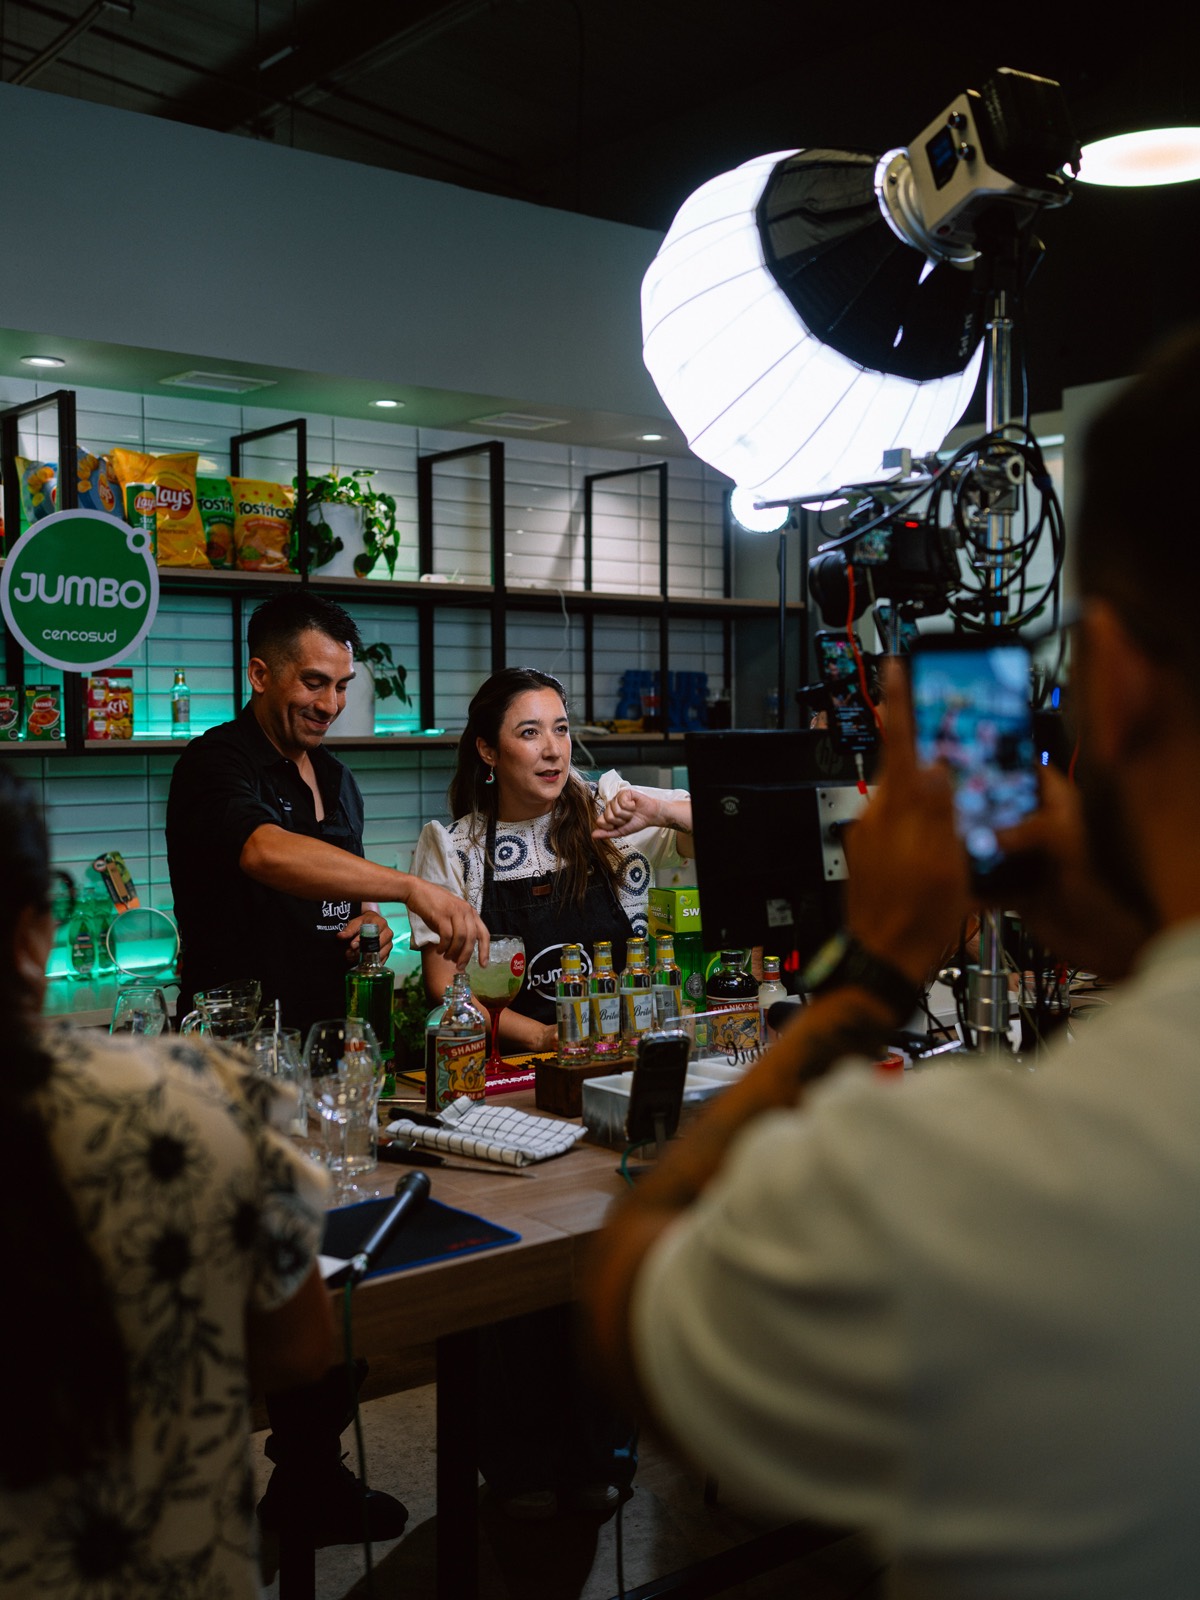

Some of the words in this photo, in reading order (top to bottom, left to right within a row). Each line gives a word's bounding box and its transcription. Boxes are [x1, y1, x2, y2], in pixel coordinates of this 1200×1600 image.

[155, 485, 191, 511] Lay's
[198, 497, 233, 512] Tostit
[13, 571, 147, 609] JUMBO
[42, 629, 117, 643] cencosud
[531, 962, 587, 987] JUMO
